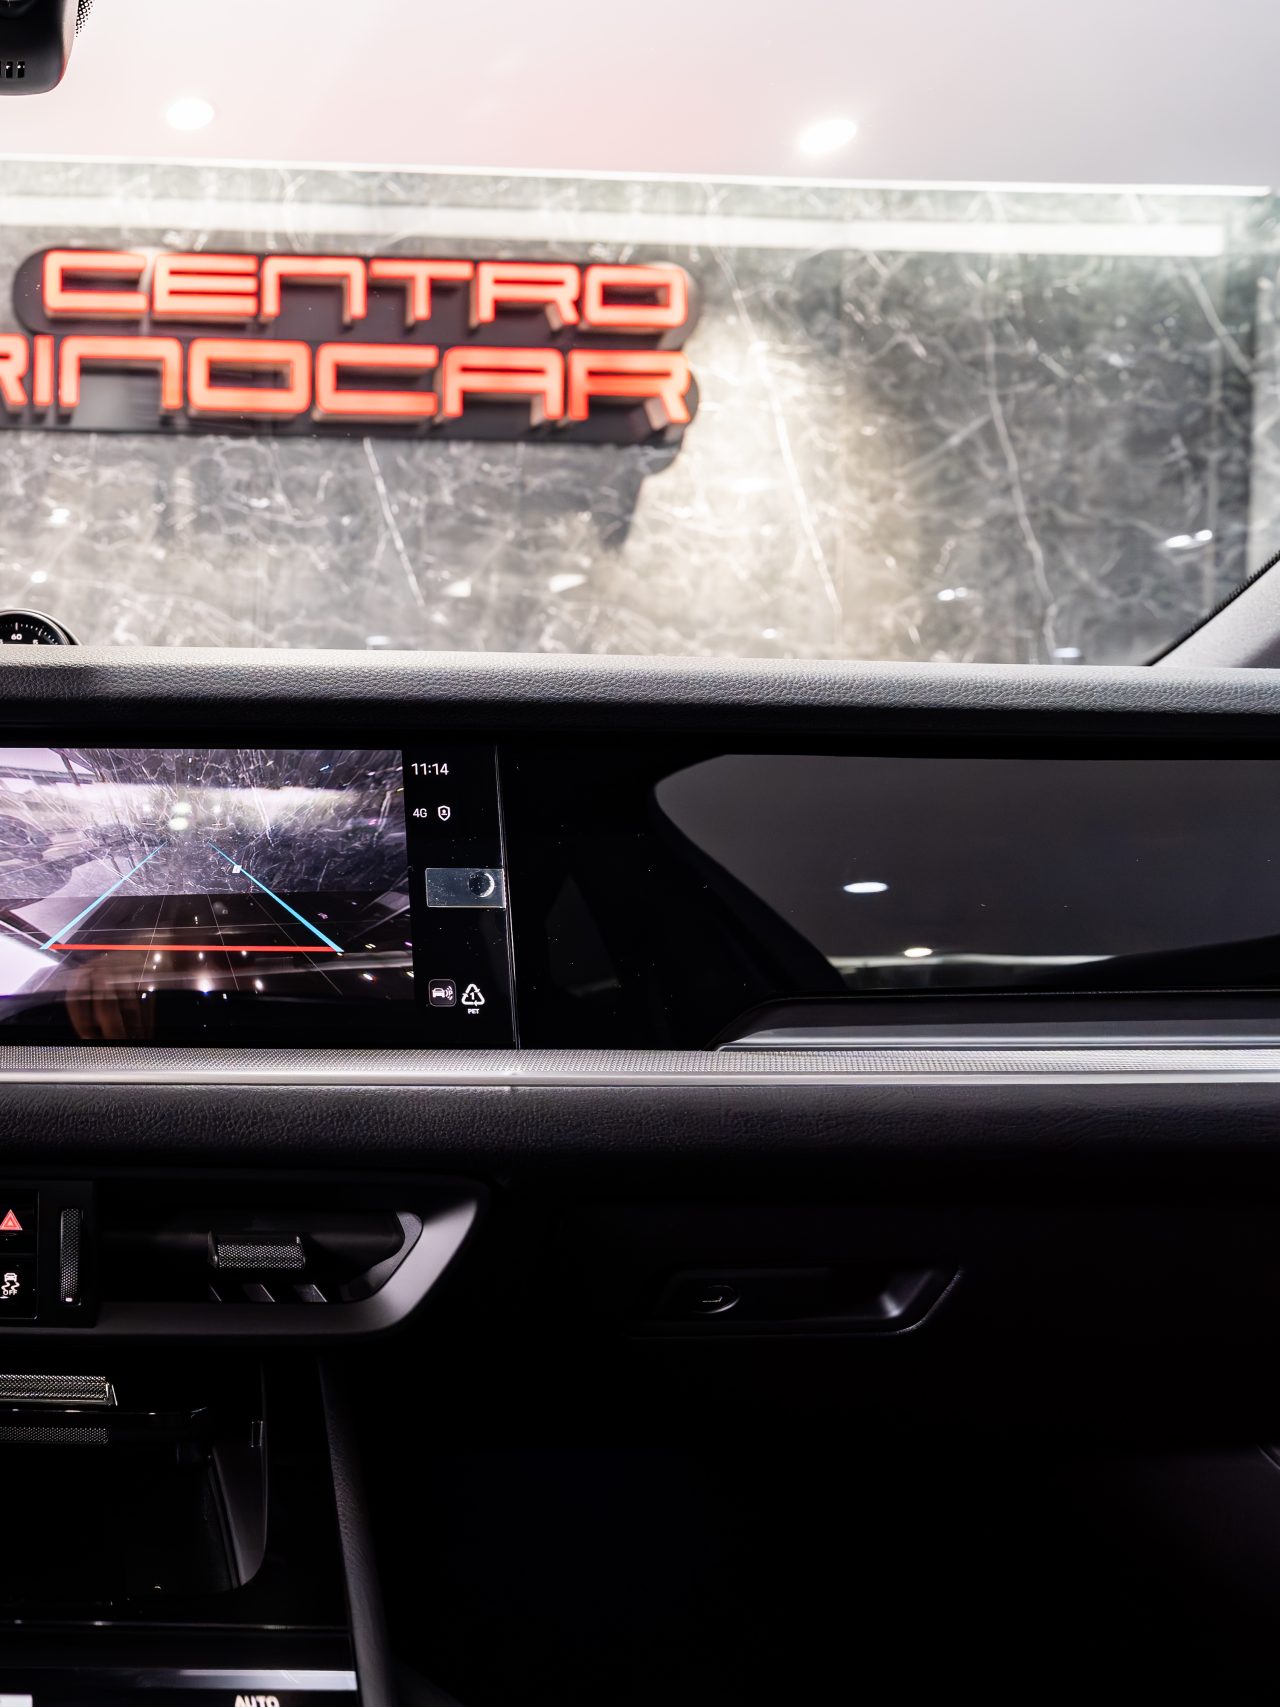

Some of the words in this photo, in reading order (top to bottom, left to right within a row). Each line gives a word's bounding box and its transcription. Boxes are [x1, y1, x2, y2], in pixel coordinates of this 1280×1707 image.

[41, 247, 690, 330] CENTRO
[10, 633, 23, 641] 60
[411, 762, 450, 776] 11:14
[412, 807, 428, 819] 4G
[234, 1694, 280, 1707] AUTO
